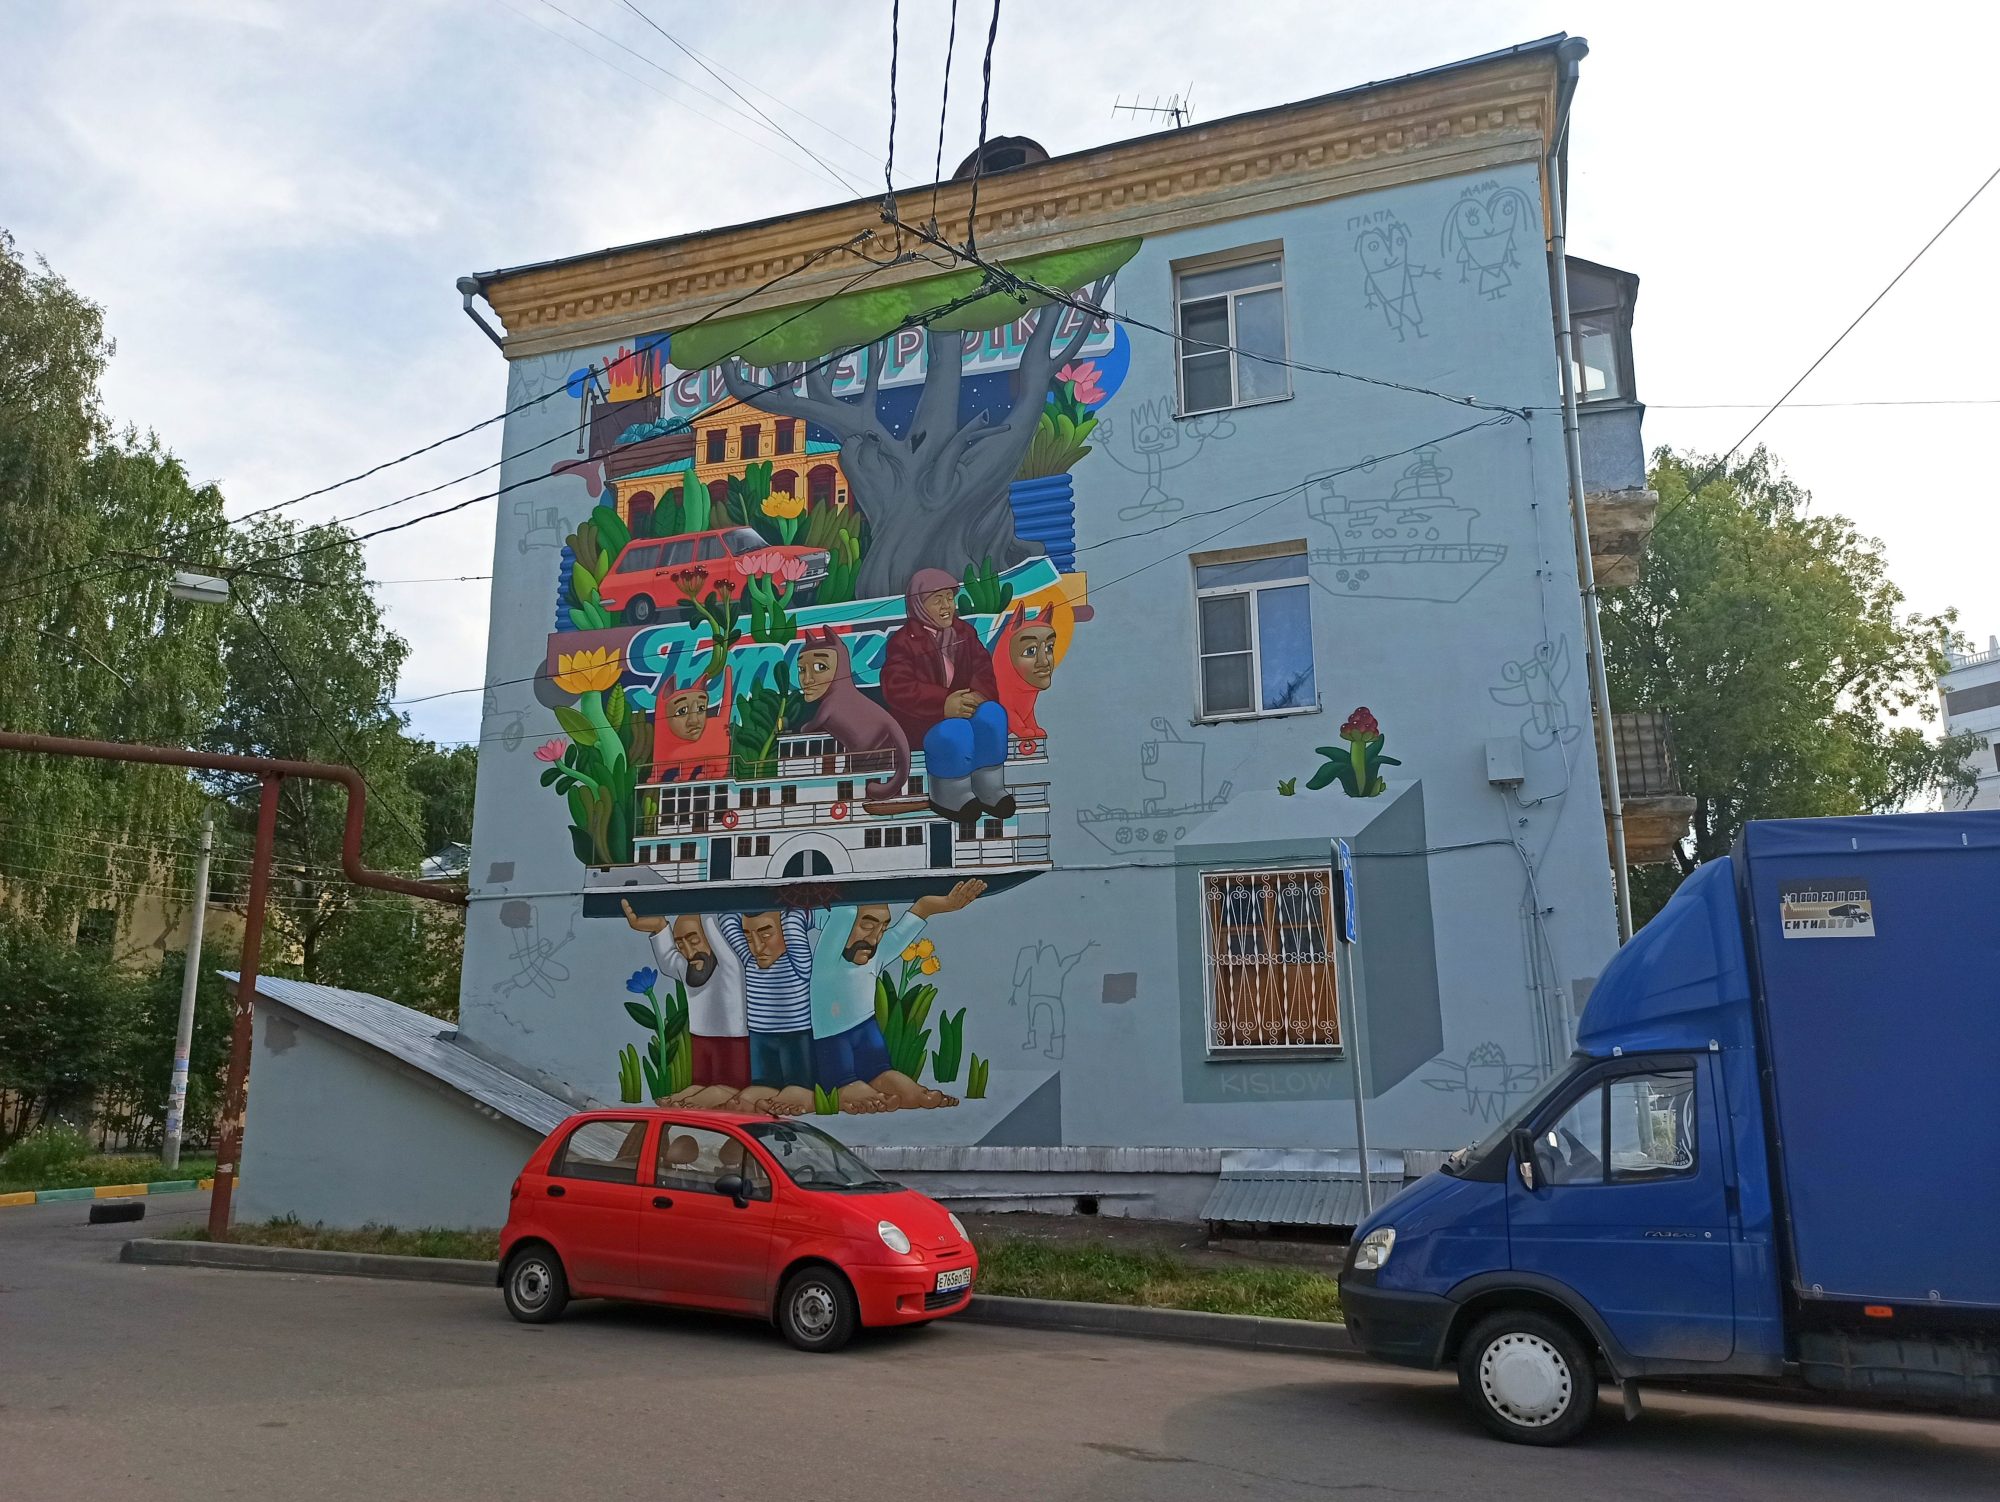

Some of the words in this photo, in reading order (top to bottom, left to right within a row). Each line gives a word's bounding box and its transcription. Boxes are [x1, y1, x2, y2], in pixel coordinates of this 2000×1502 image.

[1460, 179, 1500, 199] МАМА
[1347, 208, 1396, 232] ПАПА
[1821, 891, 1834, 903] 20
[1220, 1071, 1333, 1095] KISLOW
